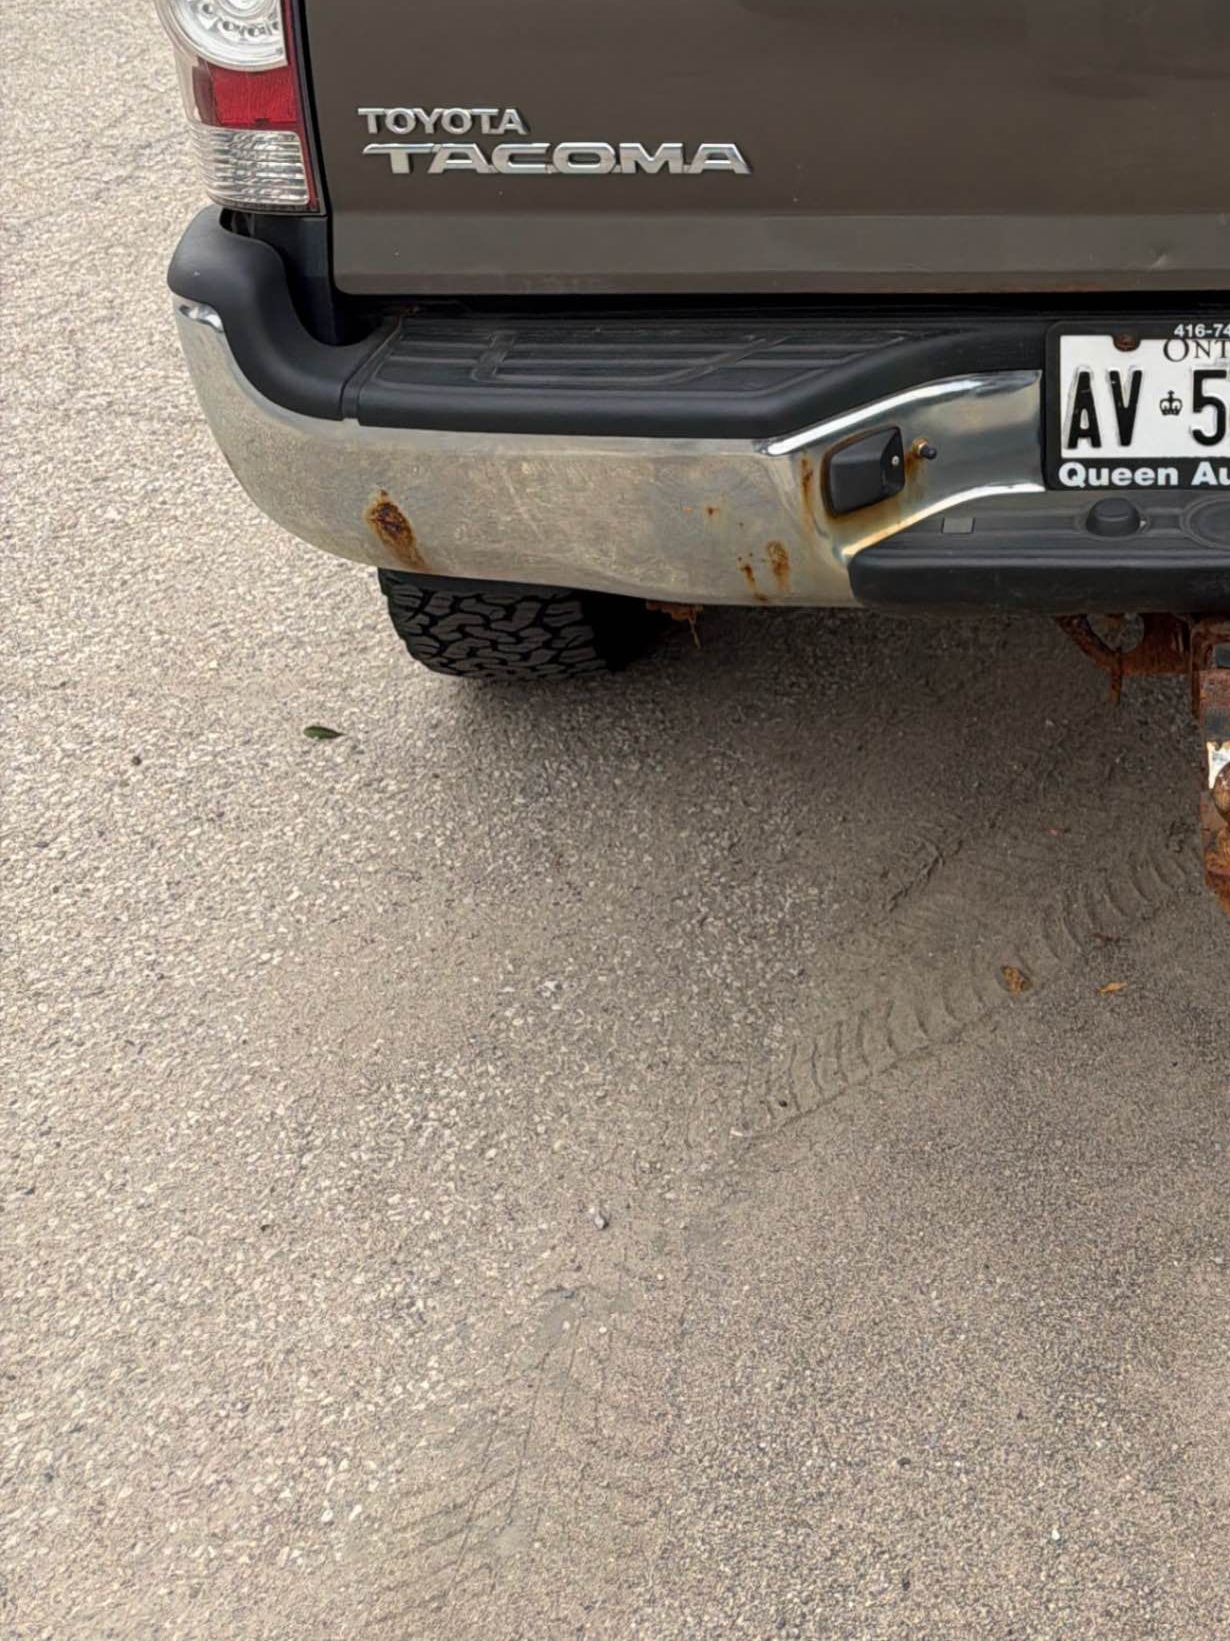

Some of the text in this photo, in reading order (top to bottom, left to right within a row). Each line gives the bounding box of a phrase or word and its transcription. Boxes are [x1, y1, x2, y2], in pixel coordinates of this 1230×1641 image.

[357, 106, 528, 136] TOYOTA
[362, 142, 752, 175] TACOMA
[1066, 370, 1144, 449] AV
[1058, 461, 1178, 489] Queen
